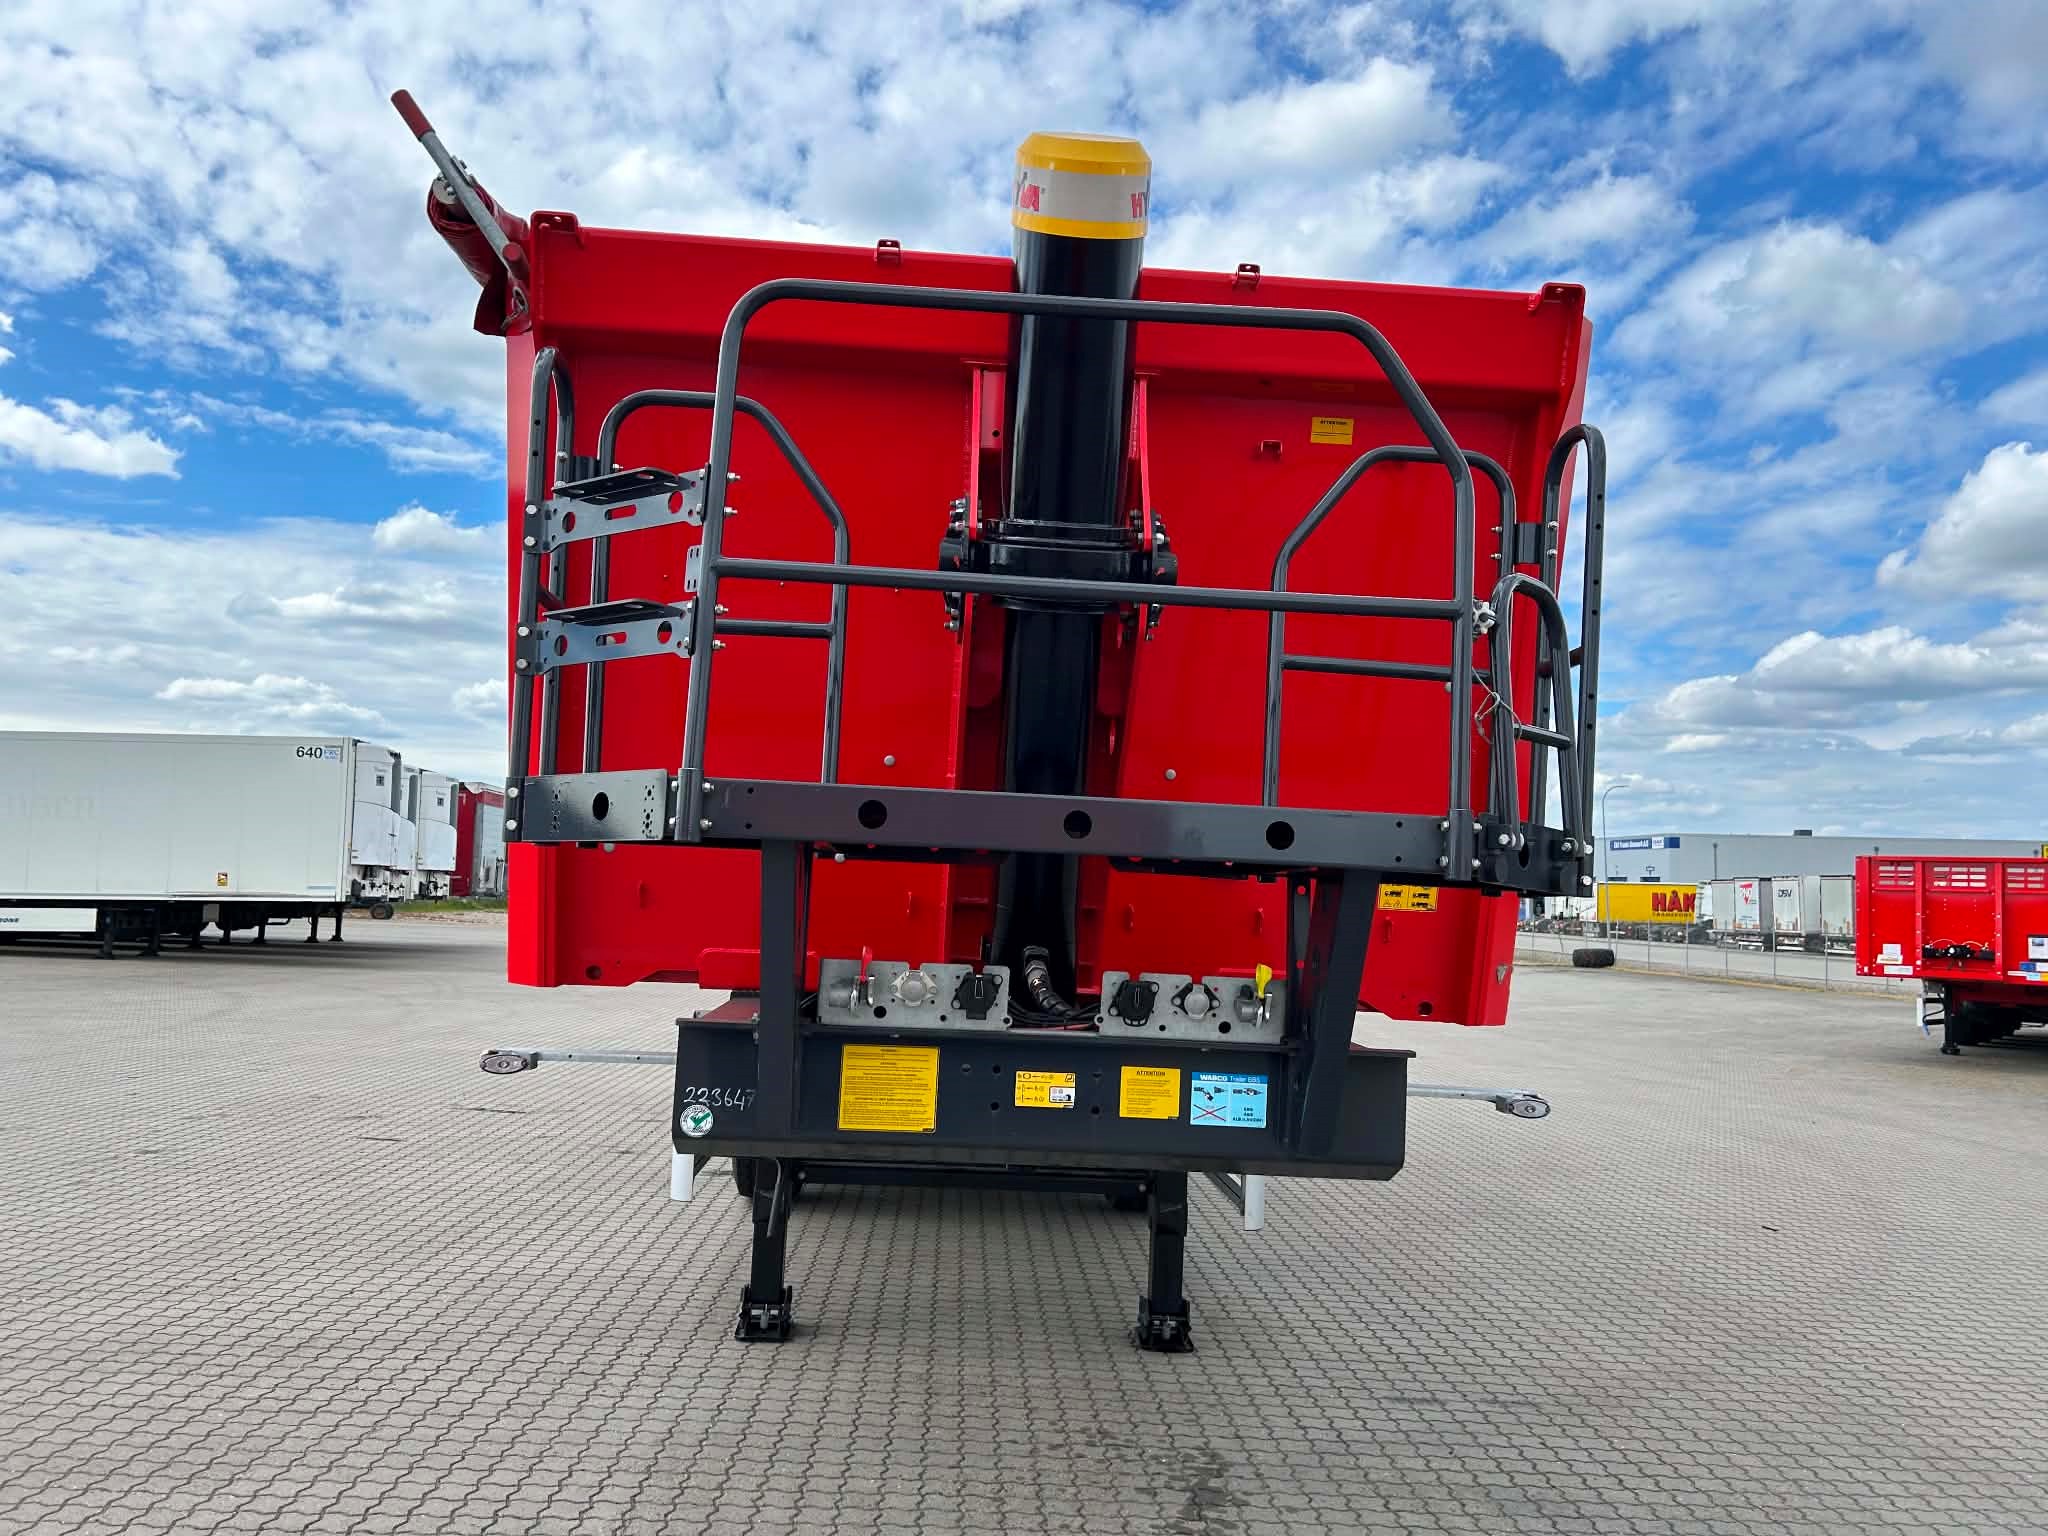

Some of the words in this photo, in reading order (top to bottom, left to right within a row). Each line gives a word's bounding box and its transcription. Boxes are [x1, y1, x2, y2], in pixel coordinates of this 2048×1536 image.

[296, 746, 323, 759] 640
[1777, 889, 1792, 898] DSV
[1651, 890, 1696, 913] HÅK
[1199, 1074, 1228, 1082] WABCO
[684, 1086, 756, 1111] 223647
